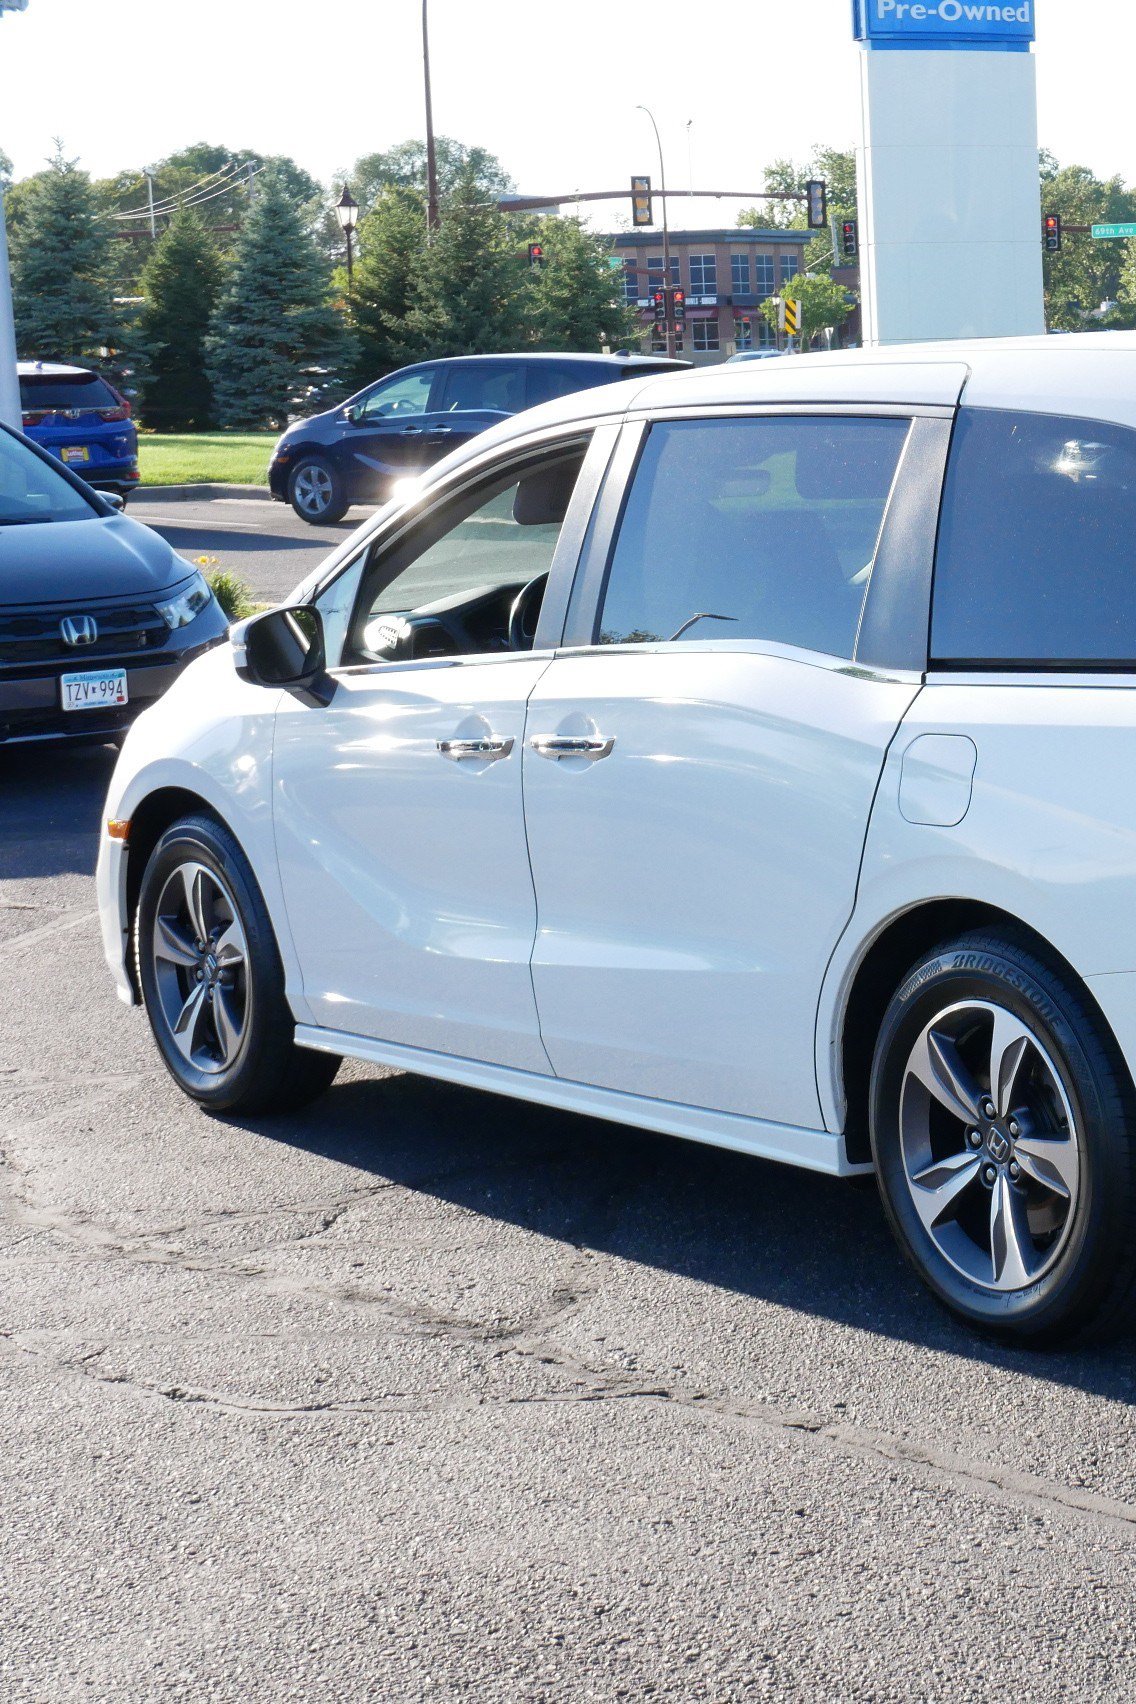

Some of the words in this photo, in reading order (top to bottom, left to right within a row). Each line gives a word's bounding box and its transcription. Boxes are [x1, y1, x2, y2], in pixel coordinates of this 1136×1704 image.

[877, 0, 1030, 23] Pre-Owned
[1095, 227, 1115, 235] 69th
[1118, 226, 1134, 235] Ave
[66, 682, 89, 701] TZV
[100, 679, 123, 697] 994
[950, 954, 1062, 1030] BRIDGESTONE
